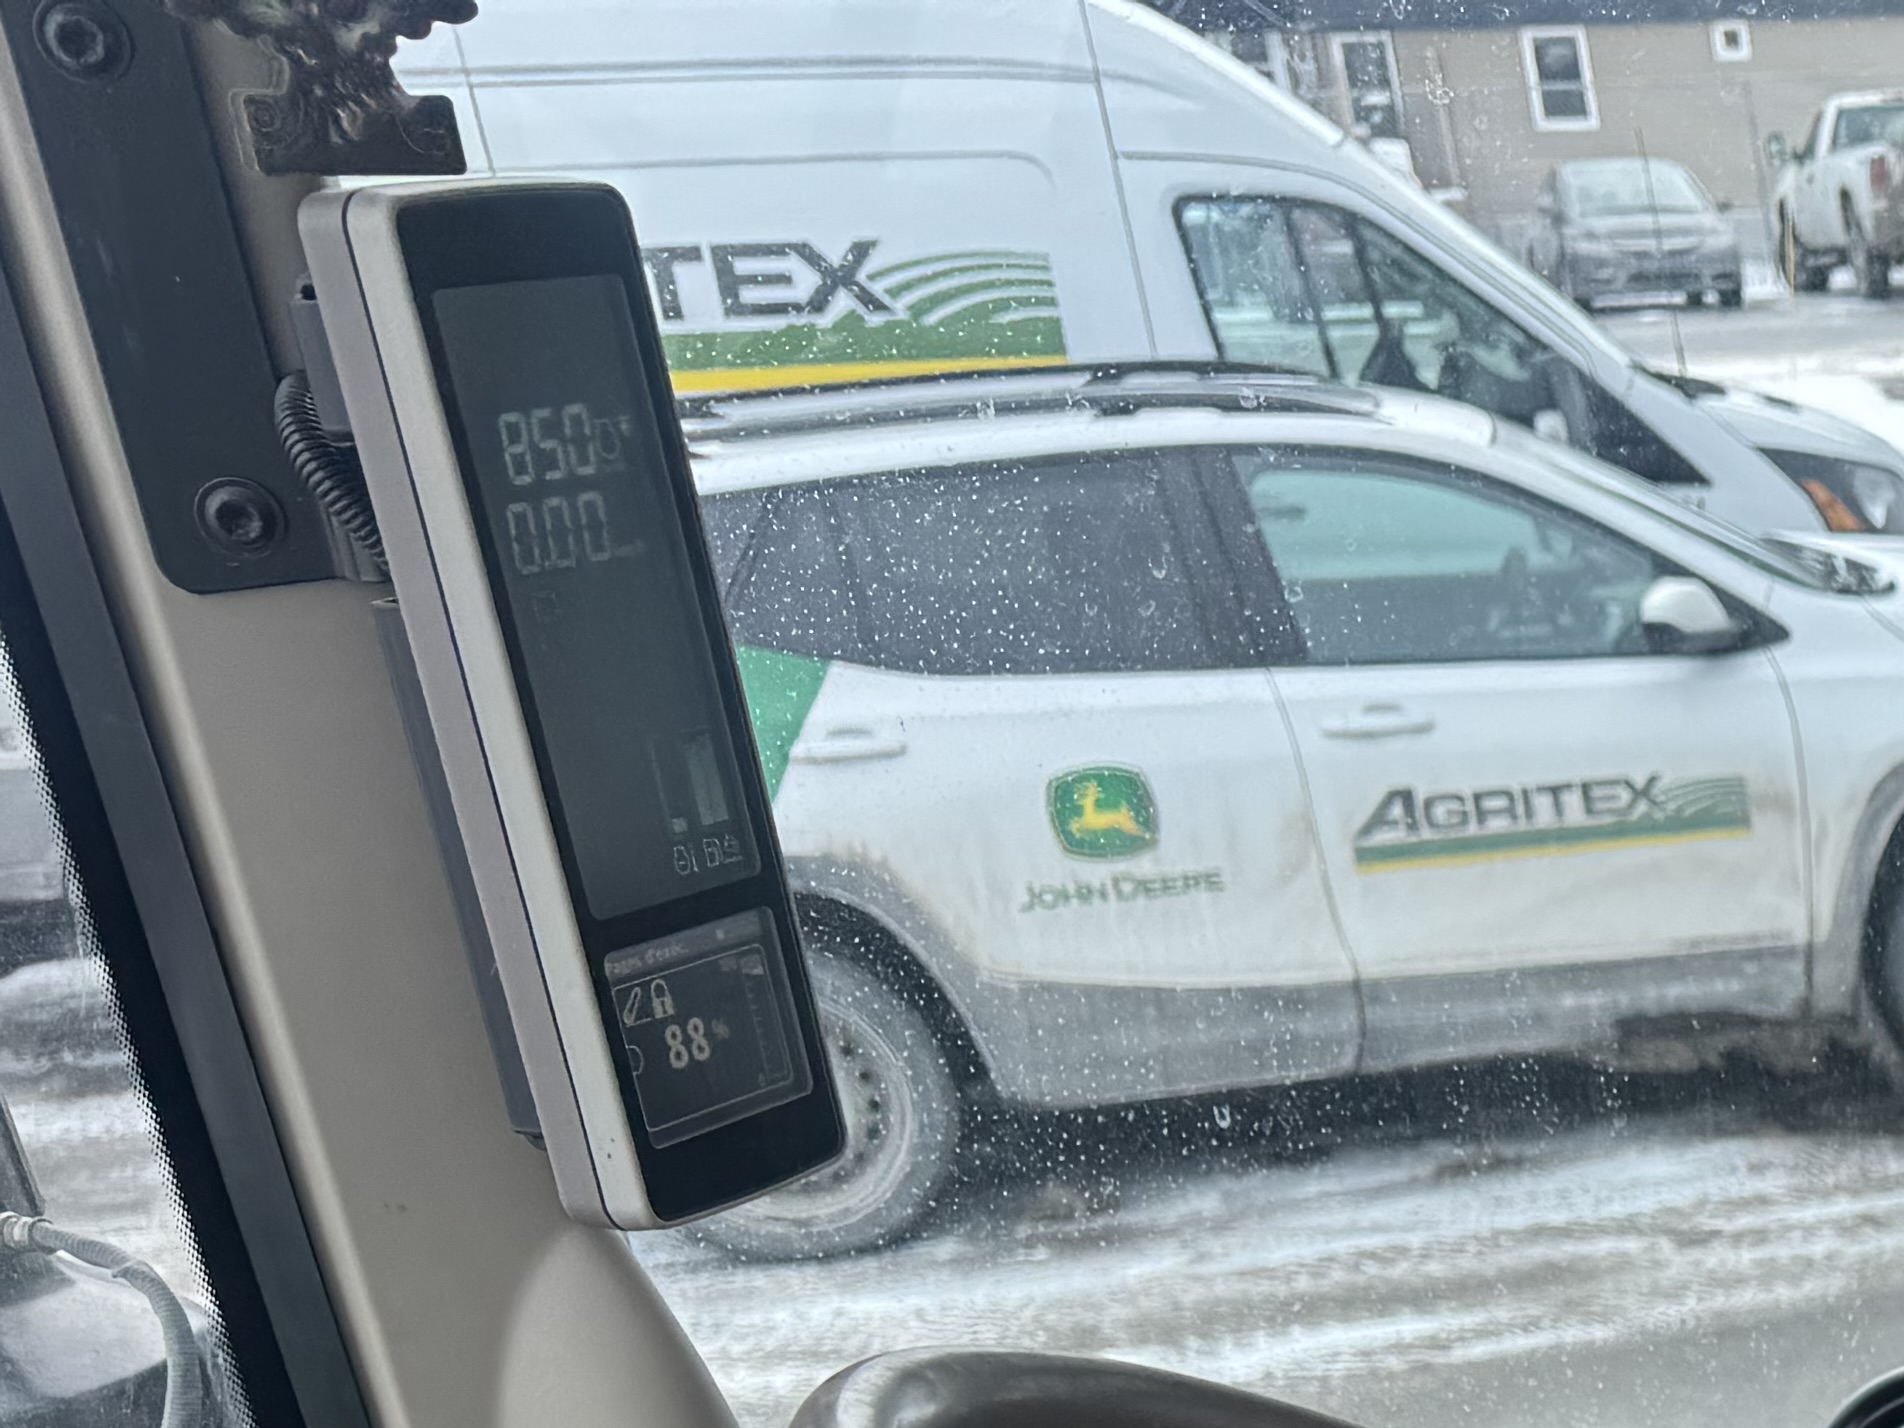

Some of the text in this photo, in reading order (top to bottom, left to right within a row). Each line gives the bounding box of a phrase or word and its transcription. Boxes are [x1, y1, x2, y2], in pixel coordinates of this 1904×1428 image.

[498, 402, 597, 486] 850
[1354, 775, 1663, 838] AGRITEX
[1018, 866, 1226, 914] JOHN DEERE
[664, 1017, 711, 1069] 88
